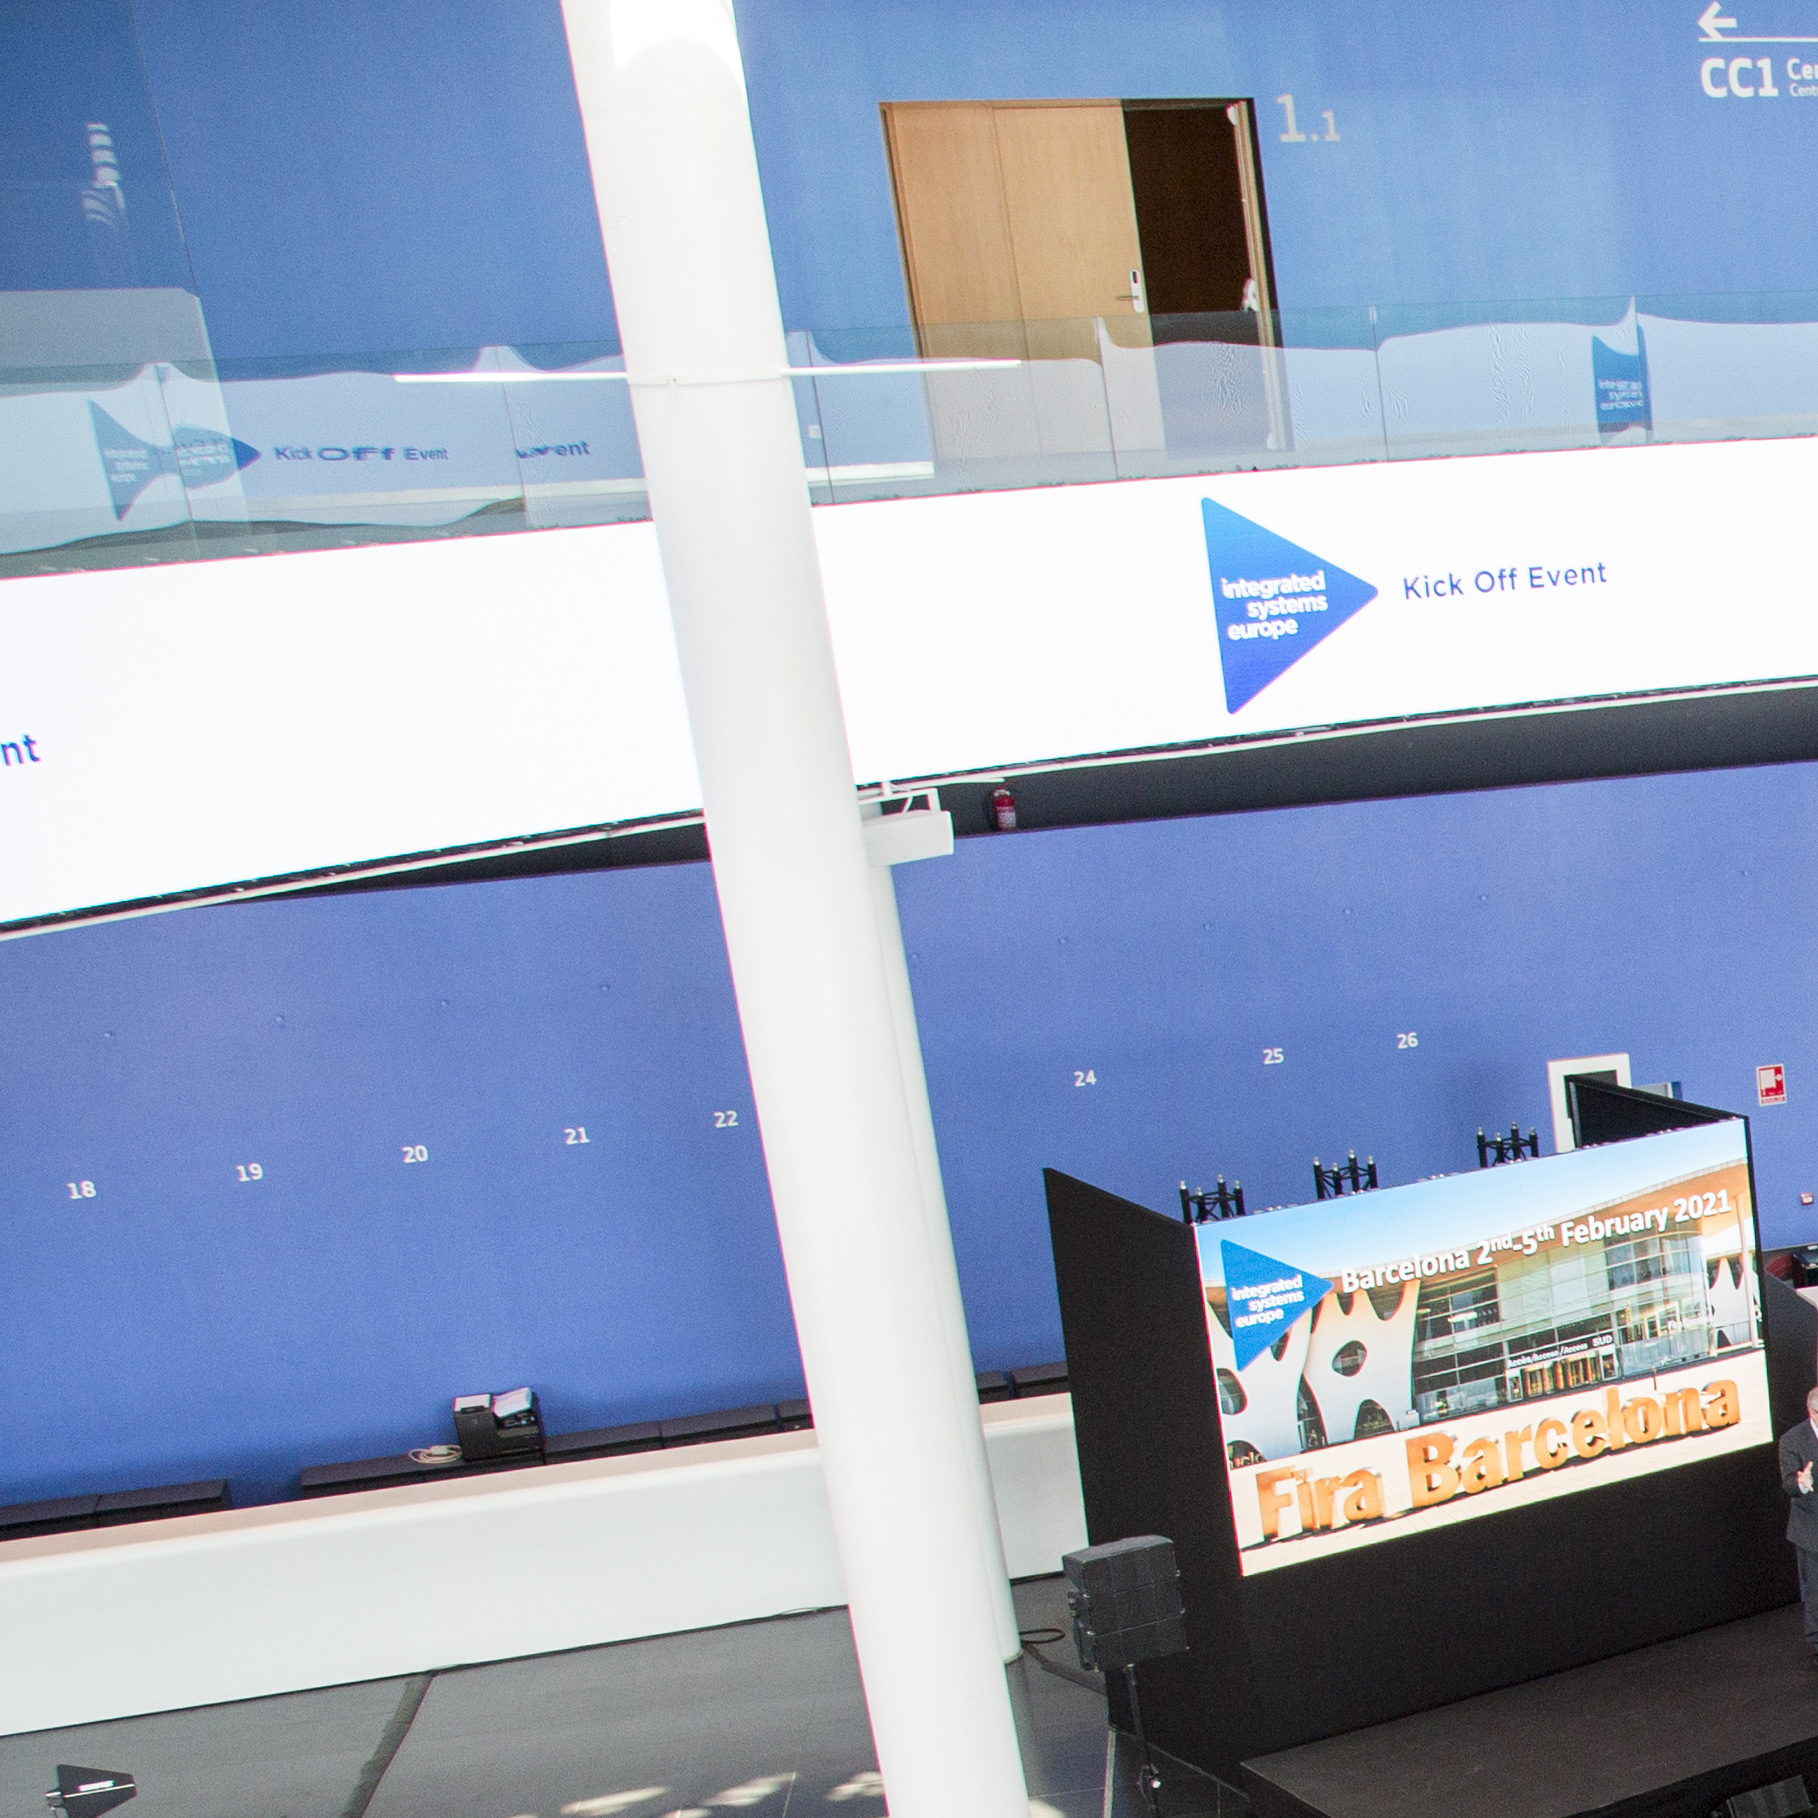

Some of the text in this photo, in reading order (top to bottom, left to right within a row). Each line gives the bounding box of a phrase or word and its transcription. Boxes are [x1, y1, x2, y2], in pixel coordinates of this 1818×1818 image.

[1701, 57, 1778, 98] CC1
[273, 446, 313, 462] Kick
[405, 447, 449, 461] Event
[1221, 570, 1326, 599] integrated
[1404, 562, 1607, 600] Kick Off Event
[1247, 594, 1329, 620] systems
[1228, 618, 1299, 640] europe
[1396, 1031, 1418, 1049] 26
[1262, 1047, 1284, 1065] 25
[1073, 1069, 1097, 1087] 24
[713, 1110, 739, 1128] 22
[563, 1126, 590, 1145] 21
[401, 1144, 428, 1164] 20
[236, 1162, 263, 1182] 19
[66, 1180, 96, 1200] 18
[1341, 1251, 1470, 1294] Barcelona
[1561, 1206, 1668, 1248] February
[1674, 1189, 1732, 1219] 2021
[1231, 1273, 1303, 1302] integrated
[1249, 1288, 1304, 1312] systems
[1235, 1307, 1284, 1329] europe
[1256, 1379, 1741, 1538] Fira Barcelona
